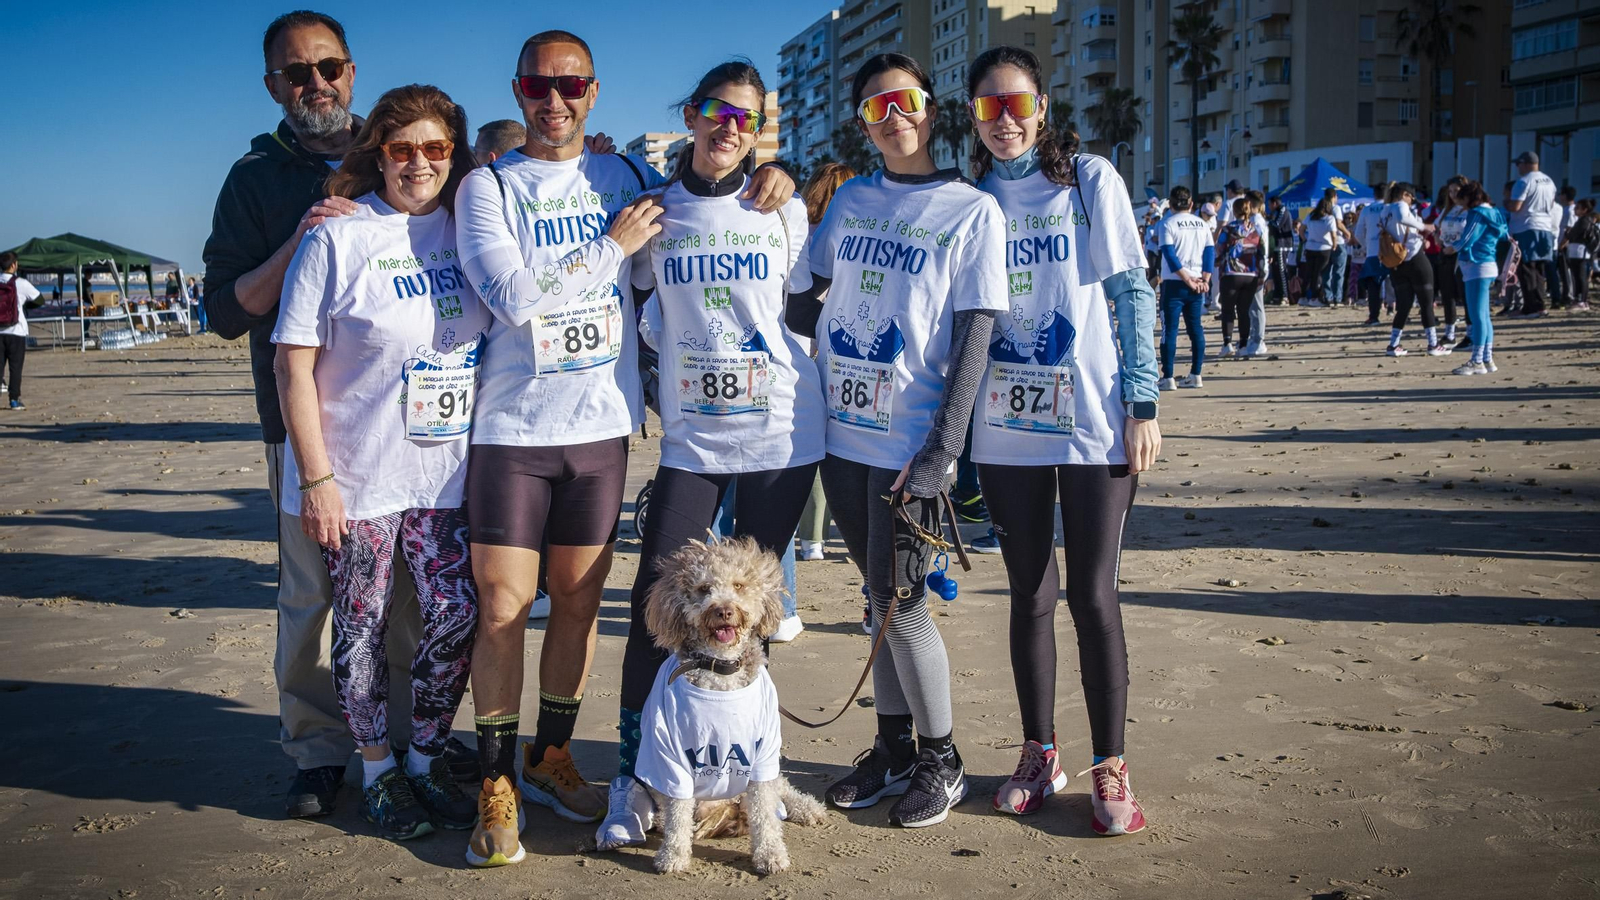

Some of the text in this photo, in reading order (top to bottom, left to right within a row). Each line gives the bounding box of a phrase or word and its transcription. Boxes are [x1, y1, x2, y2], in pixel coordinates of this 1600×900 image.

[522, 198, 566, 214] marcha
[570, 196, 578, 208] a
[584, 191, 614, 206] favor
[620, 186, 636, 203] del
[843, 216, 877, 230] marcha
[881, 220, 890, 232] a
[895, 220, 930, 240] favor
[936, 230, 958, 249] del
[1011, 219, 1017, 232] a
[1024, 214, 1063, 230] favor
[659, 230, 783, 251] marcha a favor del
[837, 235, 927, 274] AUTISMO
[1006, 234, 1068, 268] TISMO
[366, 256, 372, 271] I
[378, 256, 424, 270] marcha
[430, 252, 437, 261] a
[664, 252, 768, 285] AUTISMO
[393, 264, 464, 300] AUTISM
[733, 323, 754, 350] cuenta
[836, 308, 857, 340] Cada
[870, 316, 892, 340] cuenta
[1031, 308, 1055, 338] cuenta
[564, 323, 600, 354] 89
[416, 344, 444, 366] Cada
[702, 372, 739, 400] 88
[842, 378, 868, 408] 86
[1010, 385, 1045, 414] 87
[439, 390, 467, 419] 91
